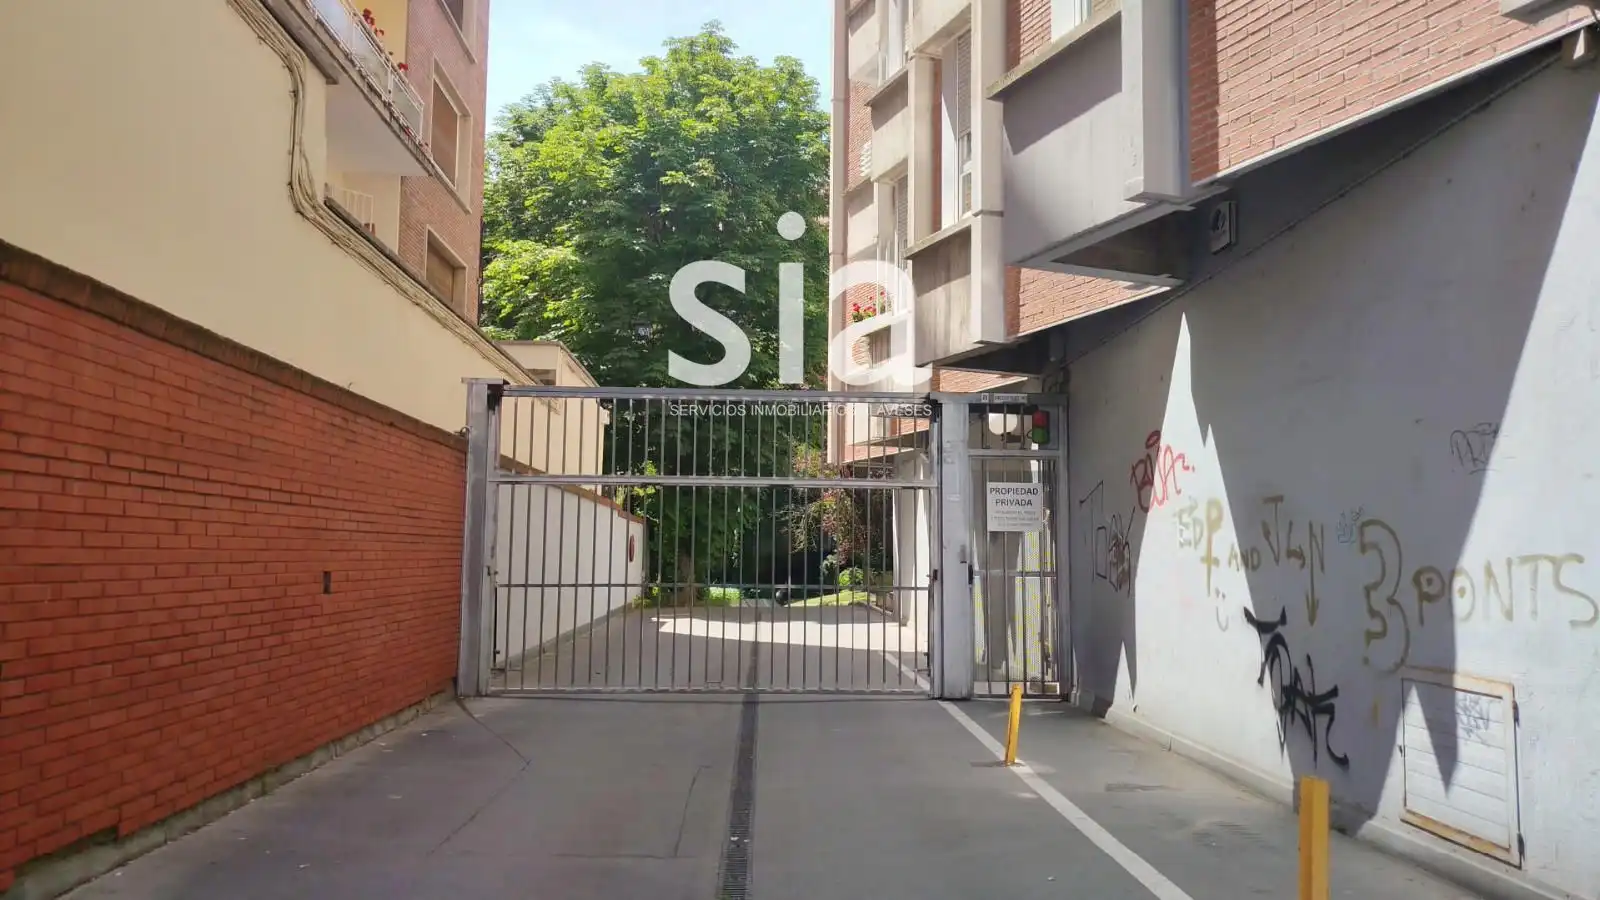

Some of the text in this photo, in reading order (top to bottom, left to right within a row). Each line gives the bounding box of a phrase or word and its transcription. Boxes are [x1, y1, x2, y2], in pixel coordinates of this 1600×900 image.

[989, 487, 1039, 496] PROPIEDAD
[995, 498, 1033, 507] PRIVADA
[1412, 553, 1600, 627] PONTS
